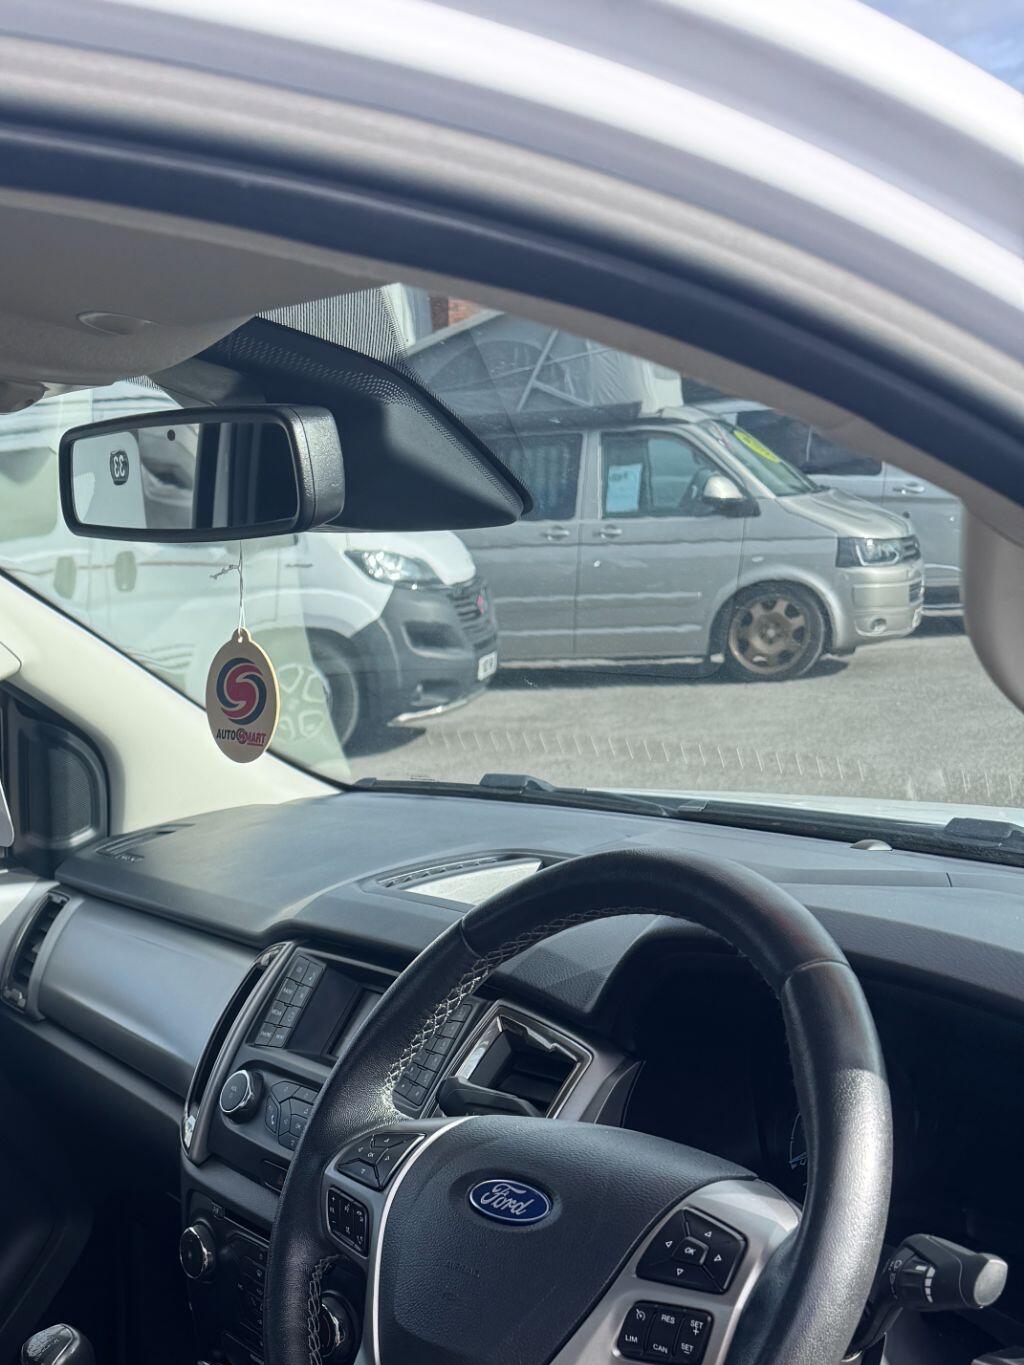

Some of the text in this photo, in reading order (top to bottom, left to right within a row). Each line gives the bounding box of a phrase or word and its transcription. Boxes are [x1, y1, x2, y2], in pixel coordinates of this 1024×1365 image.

[480, 1183, 534, 1216] Ford
[683, 1246, 696, 1256] OK
[661, 1314, 676, 1325] RES
[690, 1319, 704, 1330] SET
[625, 1334, 638, 1344] LIM
[652, 1343, 669, 1355] CAN
